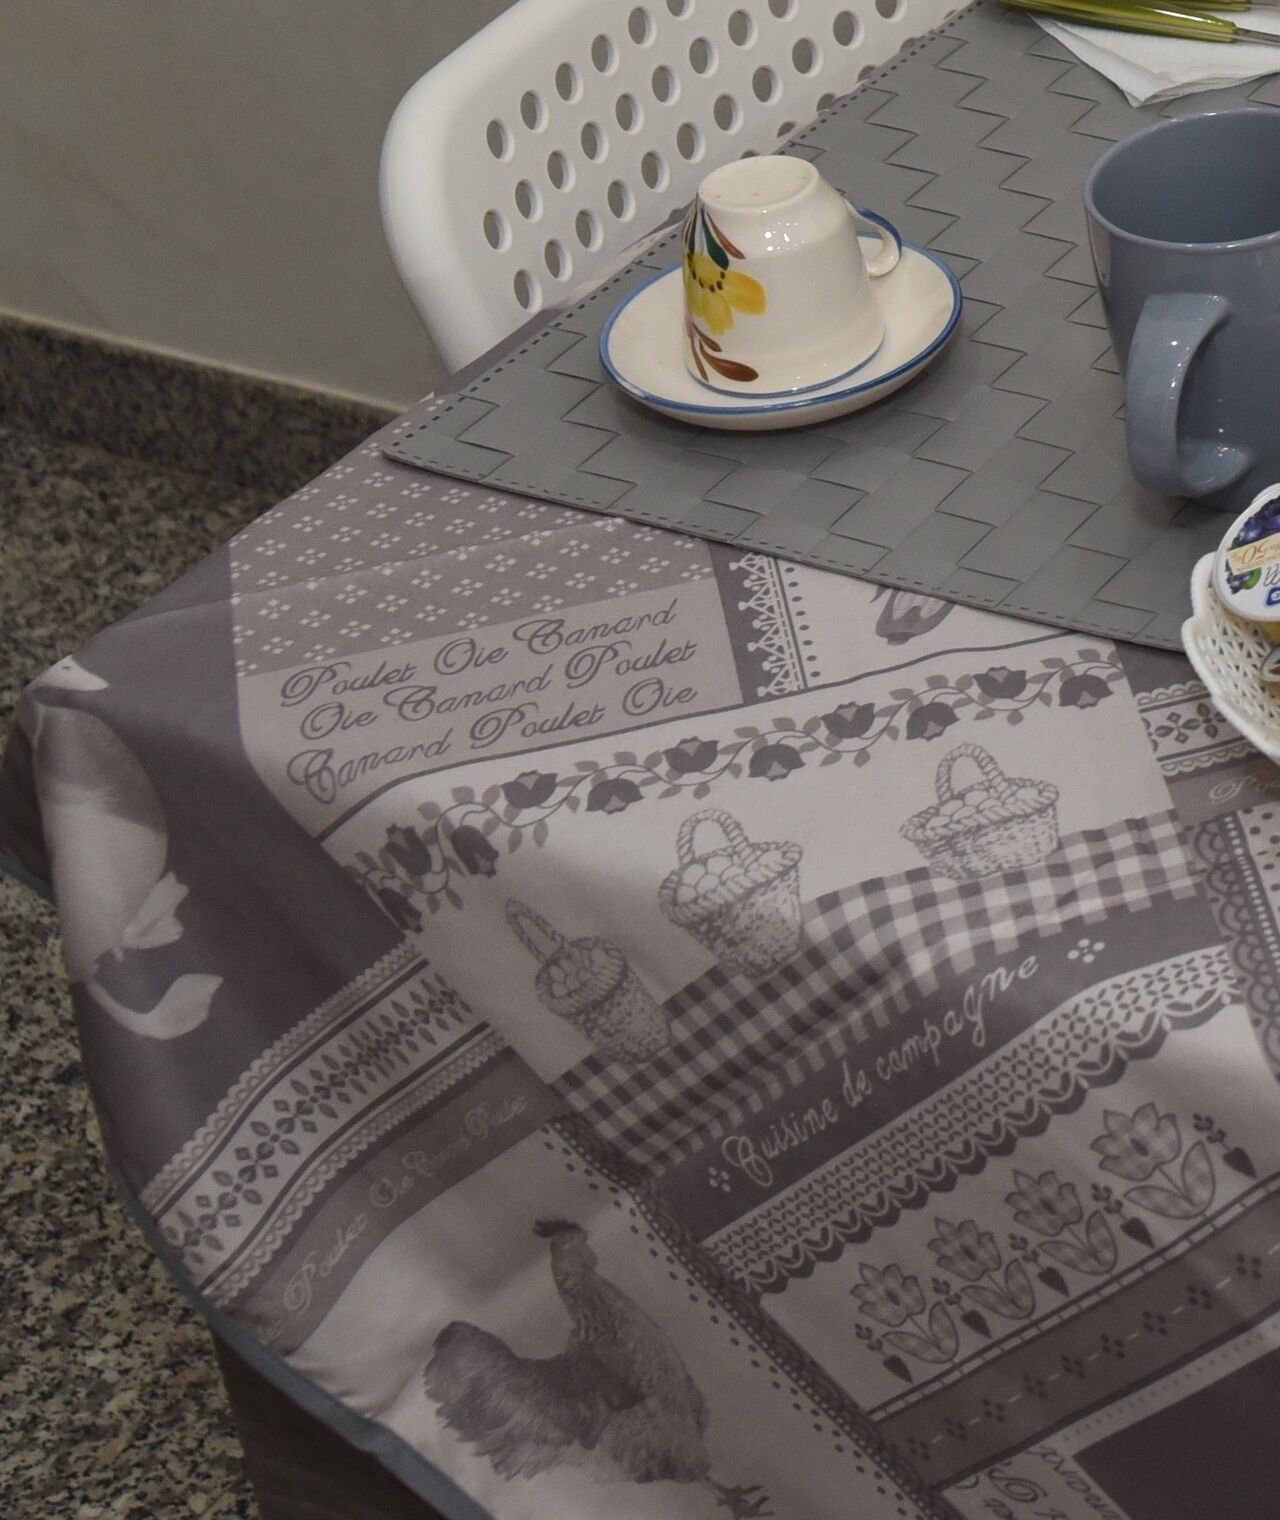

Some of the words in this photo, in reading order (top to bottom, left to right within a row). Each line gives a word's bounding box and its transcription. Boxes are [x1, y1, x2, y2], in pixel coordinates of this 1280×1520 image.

[280, 661, 416, 707] Poulet
[433, 637, 509, 677] Oie
[513, 598, 679, 655] Canard
[300, 702, 379, 740] Oie
[382, 669, 552, 722] Canard
[564, 639, 698, 688] Poulet
[286, 728, 452, 804] Canard
[469, 701, 605, 749] Poulet
[622, 677, 698, 718] Oie
[721, 1104, 840, 1187] Cuisine
[841, 1061, 874, 1109] de
[875, 953, 1039, 1082] campagne
